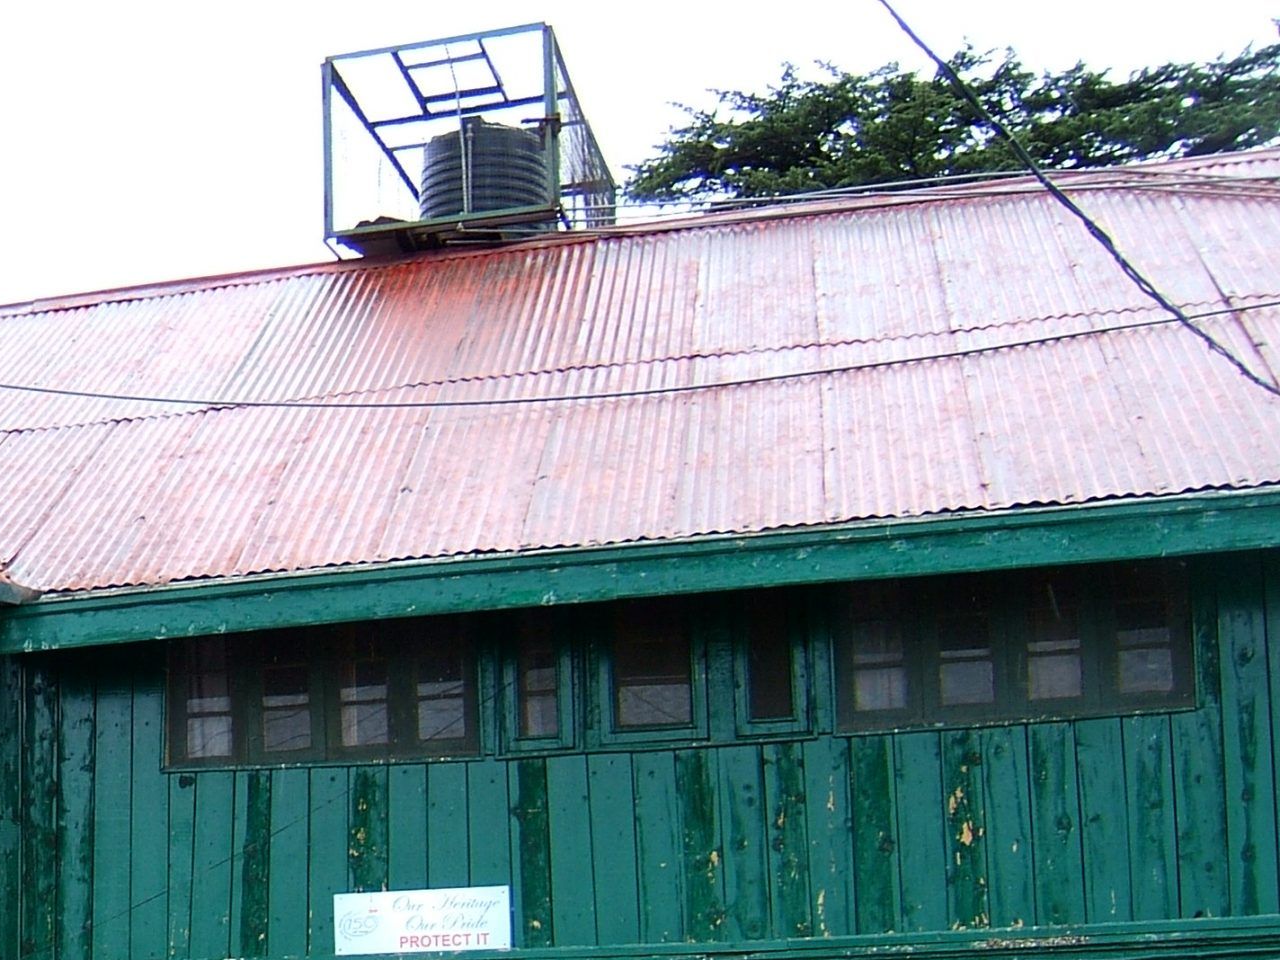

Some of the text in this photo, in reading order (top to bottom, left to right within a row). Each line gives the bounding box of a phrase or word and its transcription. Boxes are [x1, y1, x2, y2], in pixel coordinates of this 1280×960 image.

[432, 893, 501, 913] Heritage
[442, 914, 489, 931] Pride
[399, 932, 490, 949] PROTECT IT
